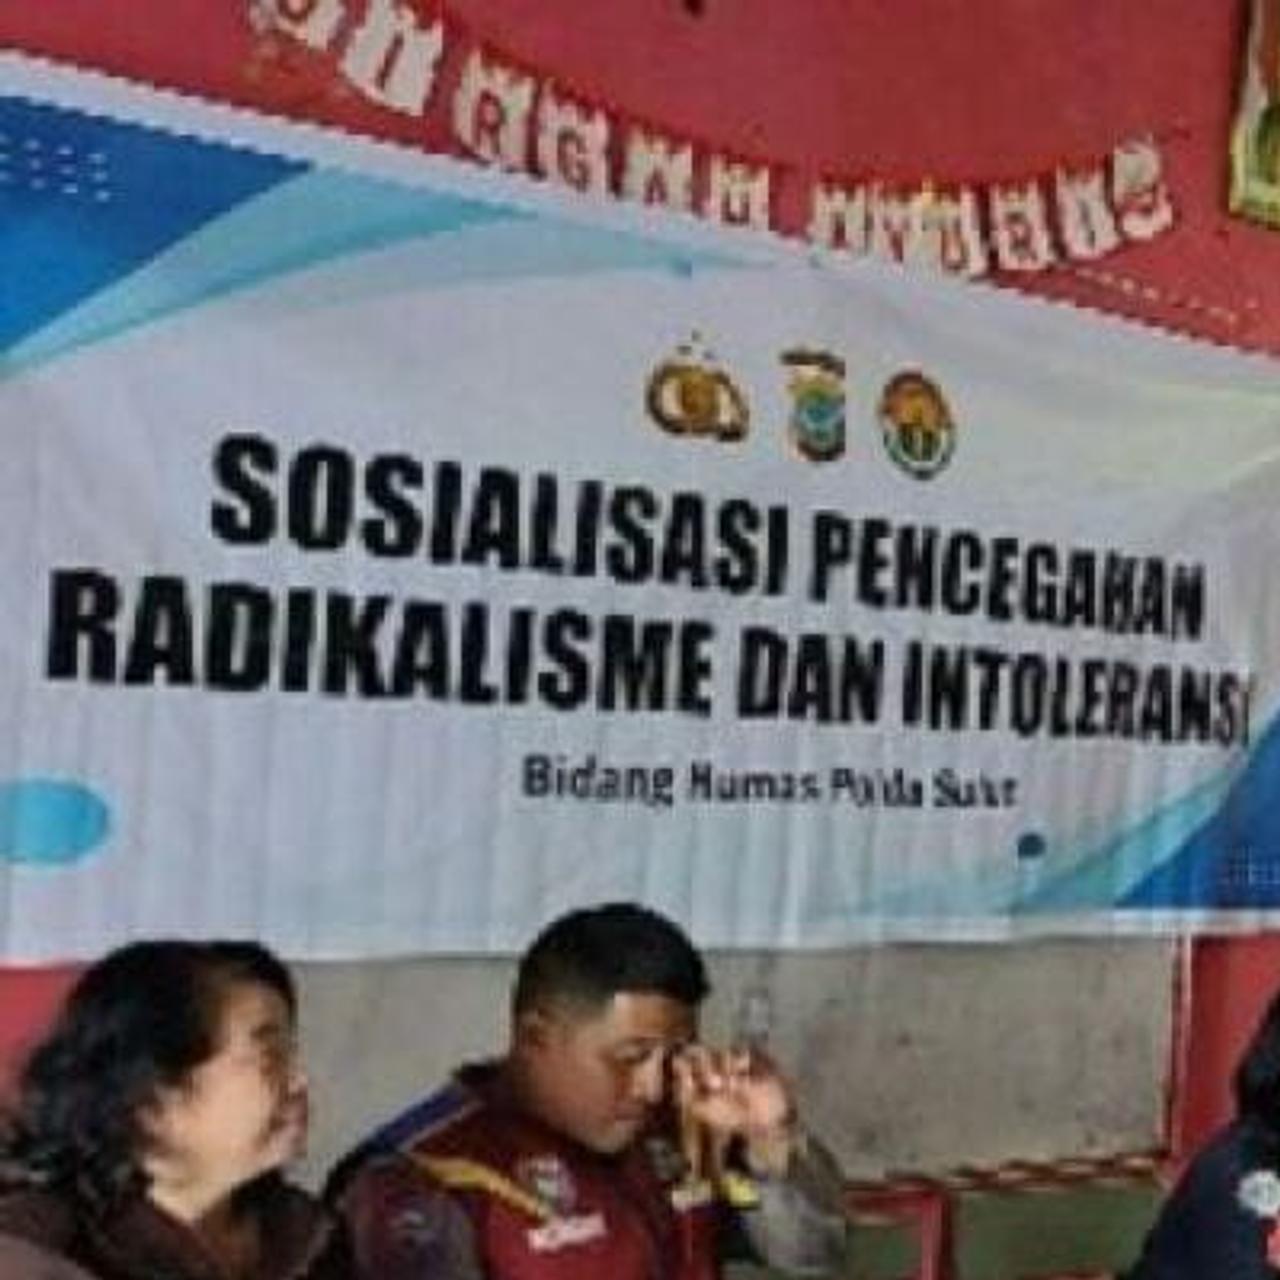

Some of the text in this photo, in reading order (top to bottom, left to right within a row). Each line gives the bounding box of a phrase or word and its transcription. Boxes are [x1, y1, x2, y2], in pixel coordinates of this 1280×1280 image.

[209, 430, 1206, 642] SOSIALISASI PENCEGAHAN
[46, 566, 1249, 749] RADIKALISME DAN INTOLERANSI
[522, 754, 674, 806] Bidang
